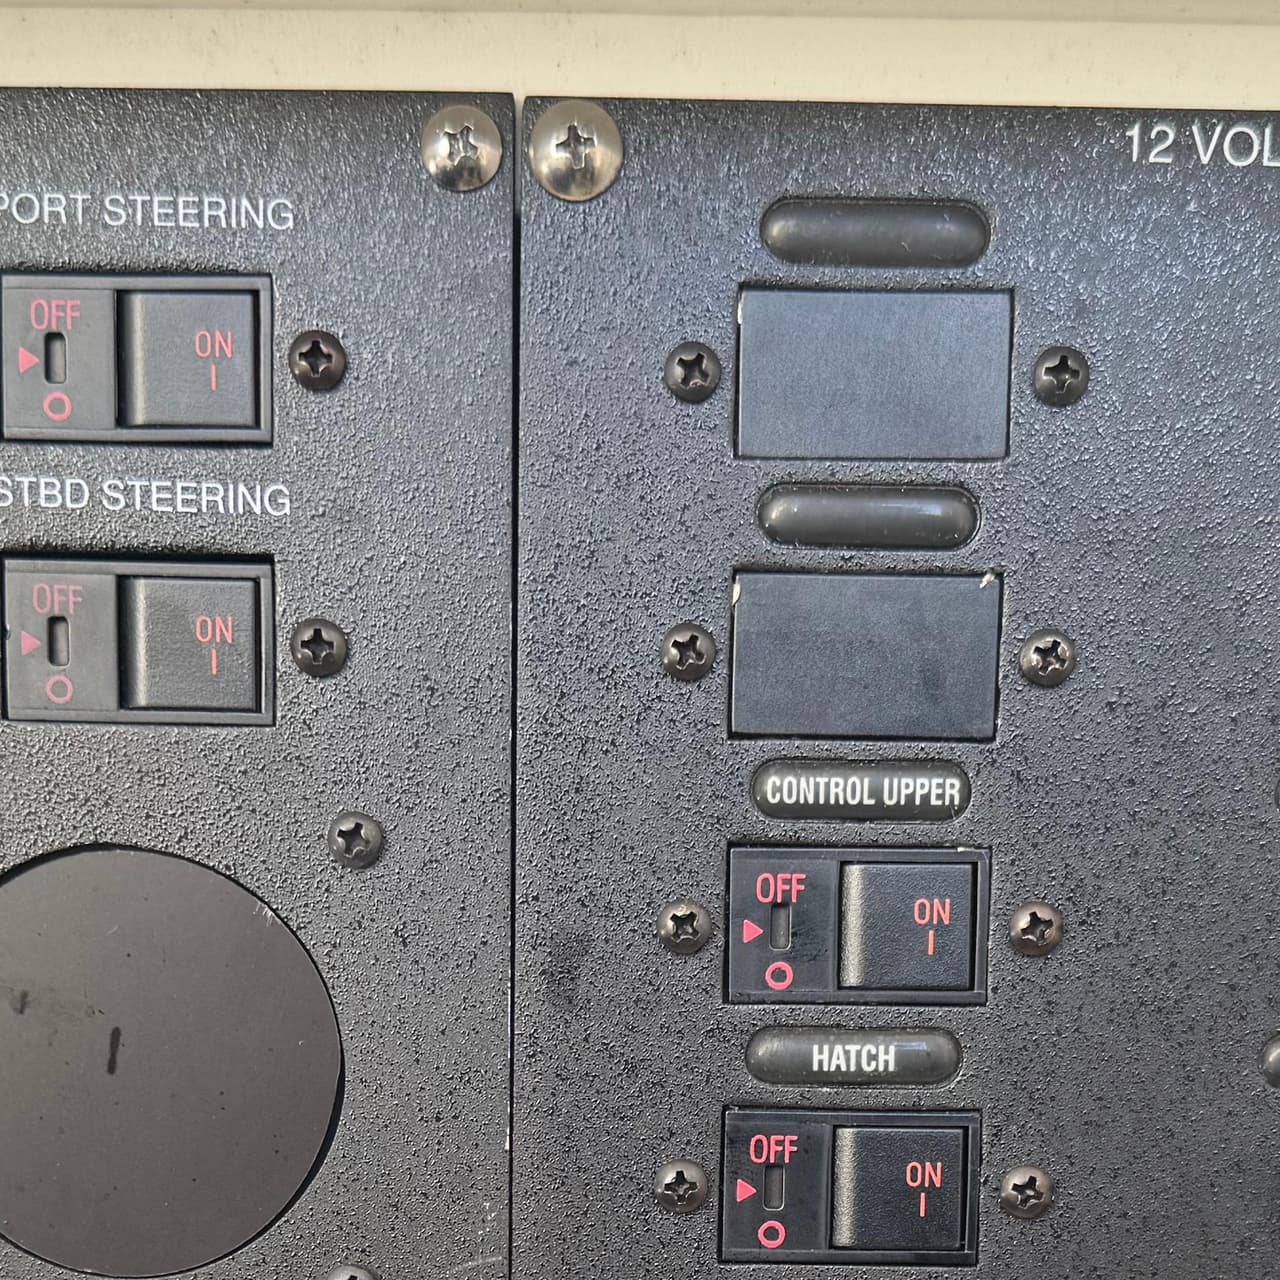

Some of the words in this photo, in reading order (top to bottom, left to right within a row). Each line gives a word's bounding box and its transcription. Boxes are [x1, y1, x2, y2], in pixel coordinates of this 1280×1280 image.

[1124, 124, 1175, 165] 12
[102, 195, 295, 231] STEERING
[29, 299, 81, 332] OFF
[194, 330, 233, 359] ON
[101, 481, 291, 516] STEERING
[32, 583, 83, 616] OFF
[195, 616, 234, 645] ON
[766, 775, 876, 806] CONTROL
[883, 777, 961, 807] UPPER
[756, 872, 807, 904] OFF
[913, 898, 952, 926] ON
[812, 1043, 897, 1074] HATCH
[749, 1134, 799, 1164] OFF
[905, 1161, 943, 1189] ON
